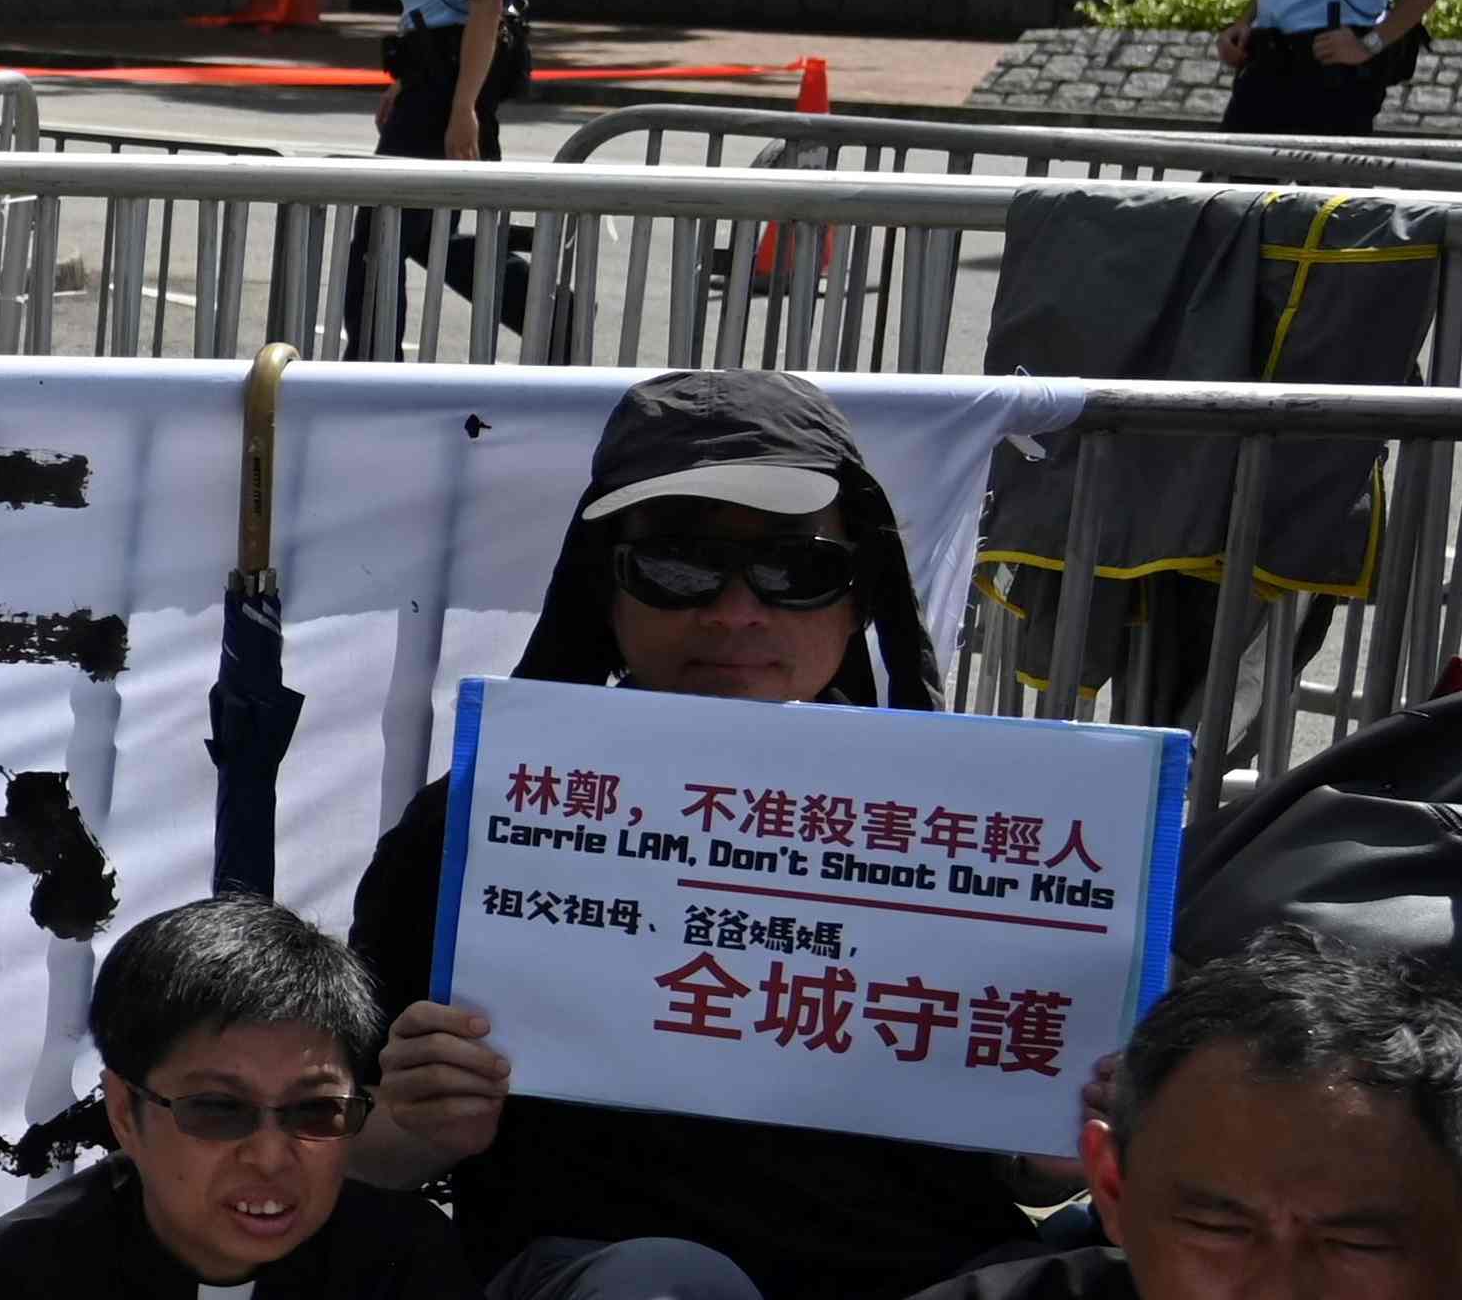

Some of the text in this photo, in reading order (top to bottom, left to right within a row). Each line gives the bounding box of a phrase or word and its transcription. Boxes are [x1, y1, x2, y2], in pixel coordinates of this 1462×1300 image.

[488, 816, 1115, 910] Carrie LAM, Don't Shoot Our Kids
[653, 952, 1072, 1077] 全城守護
